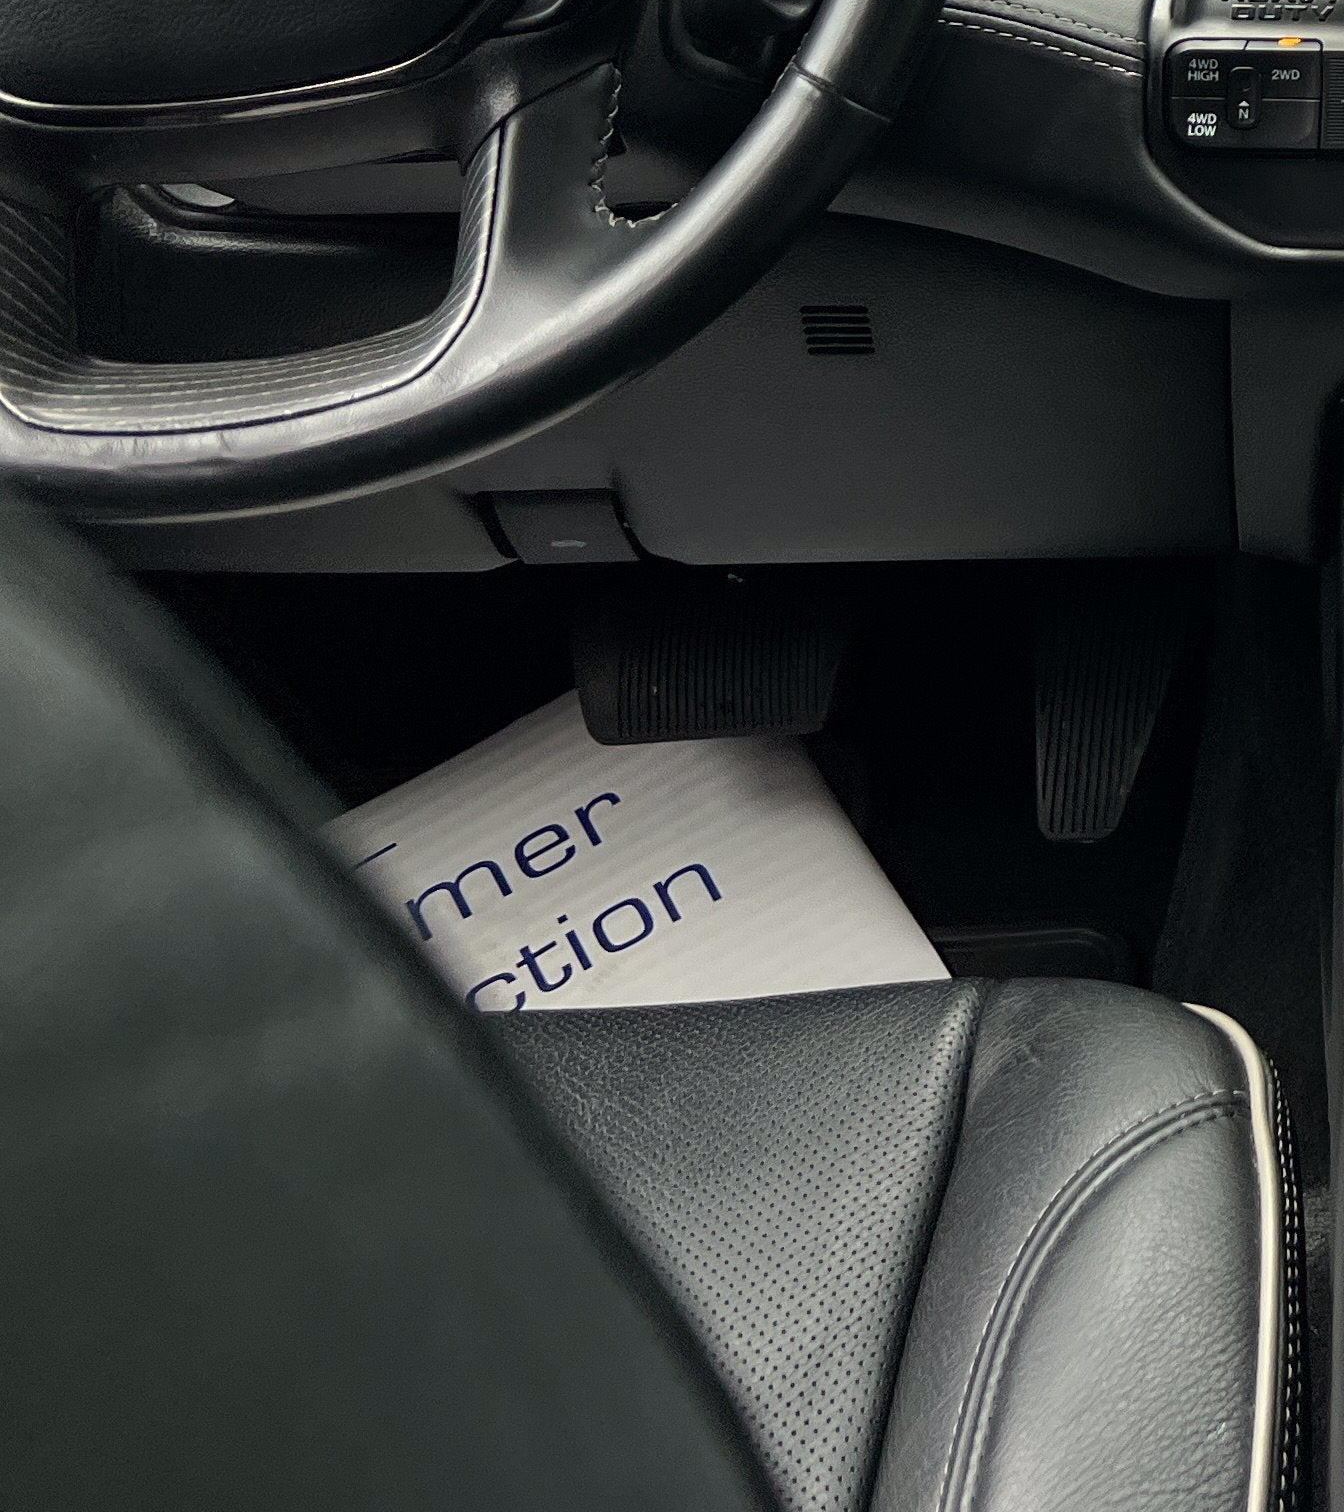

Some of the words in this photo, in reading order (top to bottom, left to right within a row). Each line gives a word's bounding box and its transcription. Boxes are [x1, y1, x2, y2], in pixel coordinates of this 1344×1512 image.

[1231, 3, 1336, 22] DUTY
[1188, 58, 1219, 71] 4WD
[1187, 70, 1220, 83] HIGH
[1271, 68, 1301, 81] 2WD
[1187, 113, 1218, 125] 4WD
[1238, 108, 1249, 120] N
[1187, 124, 1217, 137] LOW
[404, 791, 622, 942] mer
